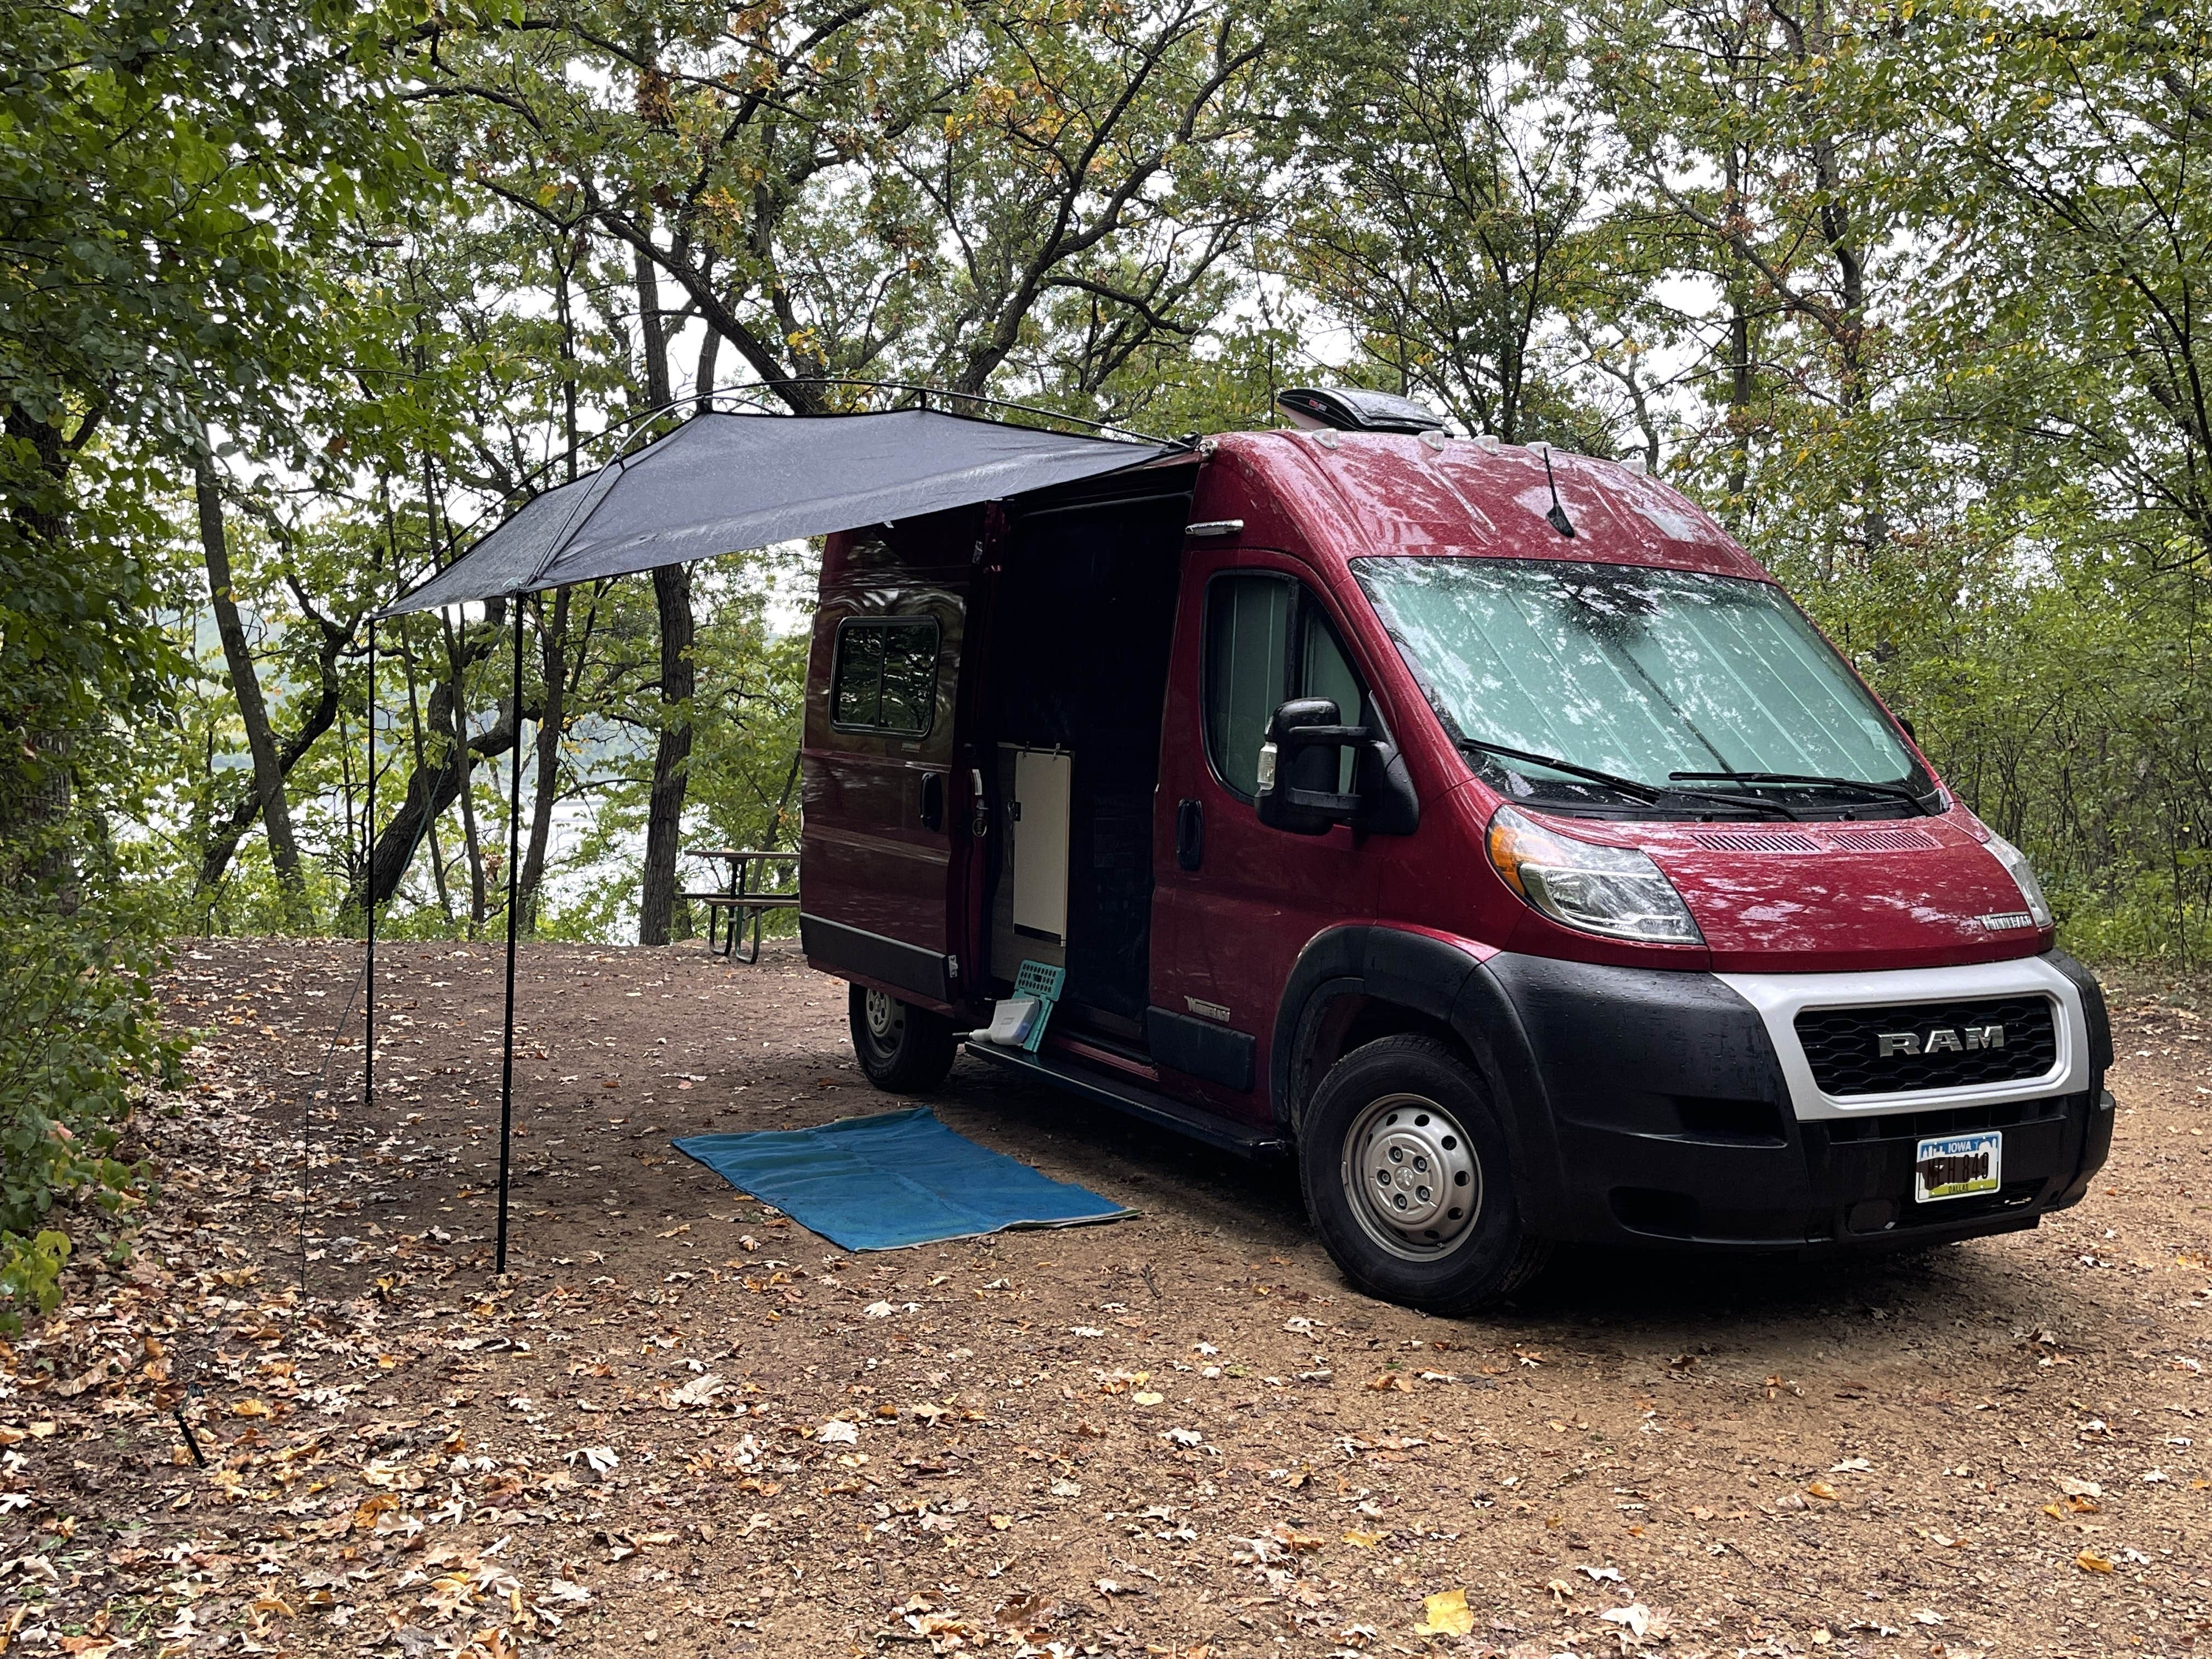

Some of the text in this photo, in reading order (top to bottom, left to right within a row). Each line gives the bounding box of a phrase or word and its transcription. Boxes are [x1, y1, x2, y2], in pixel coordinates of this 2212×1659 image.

[1877, 1025, 2005, 1057] RAM
[1948, 1141, 1972, 1153] IOWA
[1948, 1183, 1970, 1194] DALLAS
